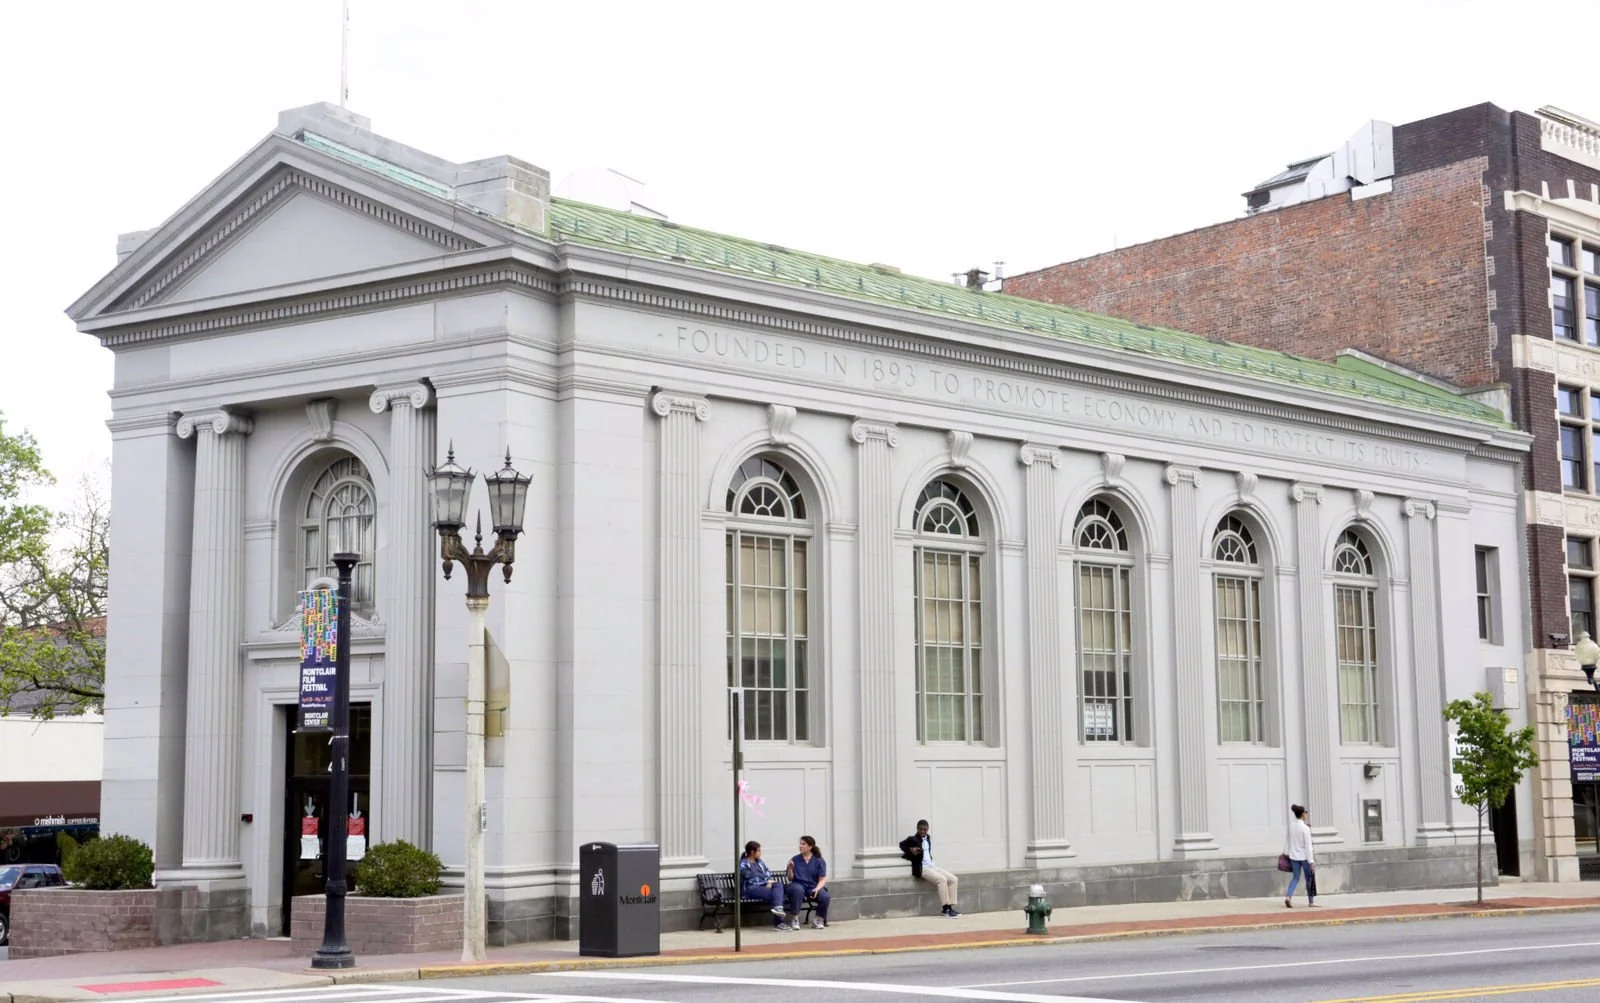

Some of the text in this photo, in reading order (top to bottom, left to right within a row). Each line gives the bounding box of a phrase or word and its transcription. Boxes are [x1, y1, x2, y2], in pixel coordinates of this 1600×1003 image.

[676, 326, 1420, 470] FOUNDED IN 1893 TO PROMOTE ECONOMY AND TO PROTECT ITS FRUITS
[302, 667, 336, 676] MONTCLAIR
[302, 676, 316, 684] FILM
[302, 683, 328, 692] FESTIVAL
[40, 814, 66, 826] mishmish
[619, 895, 657, 905] Montclair
